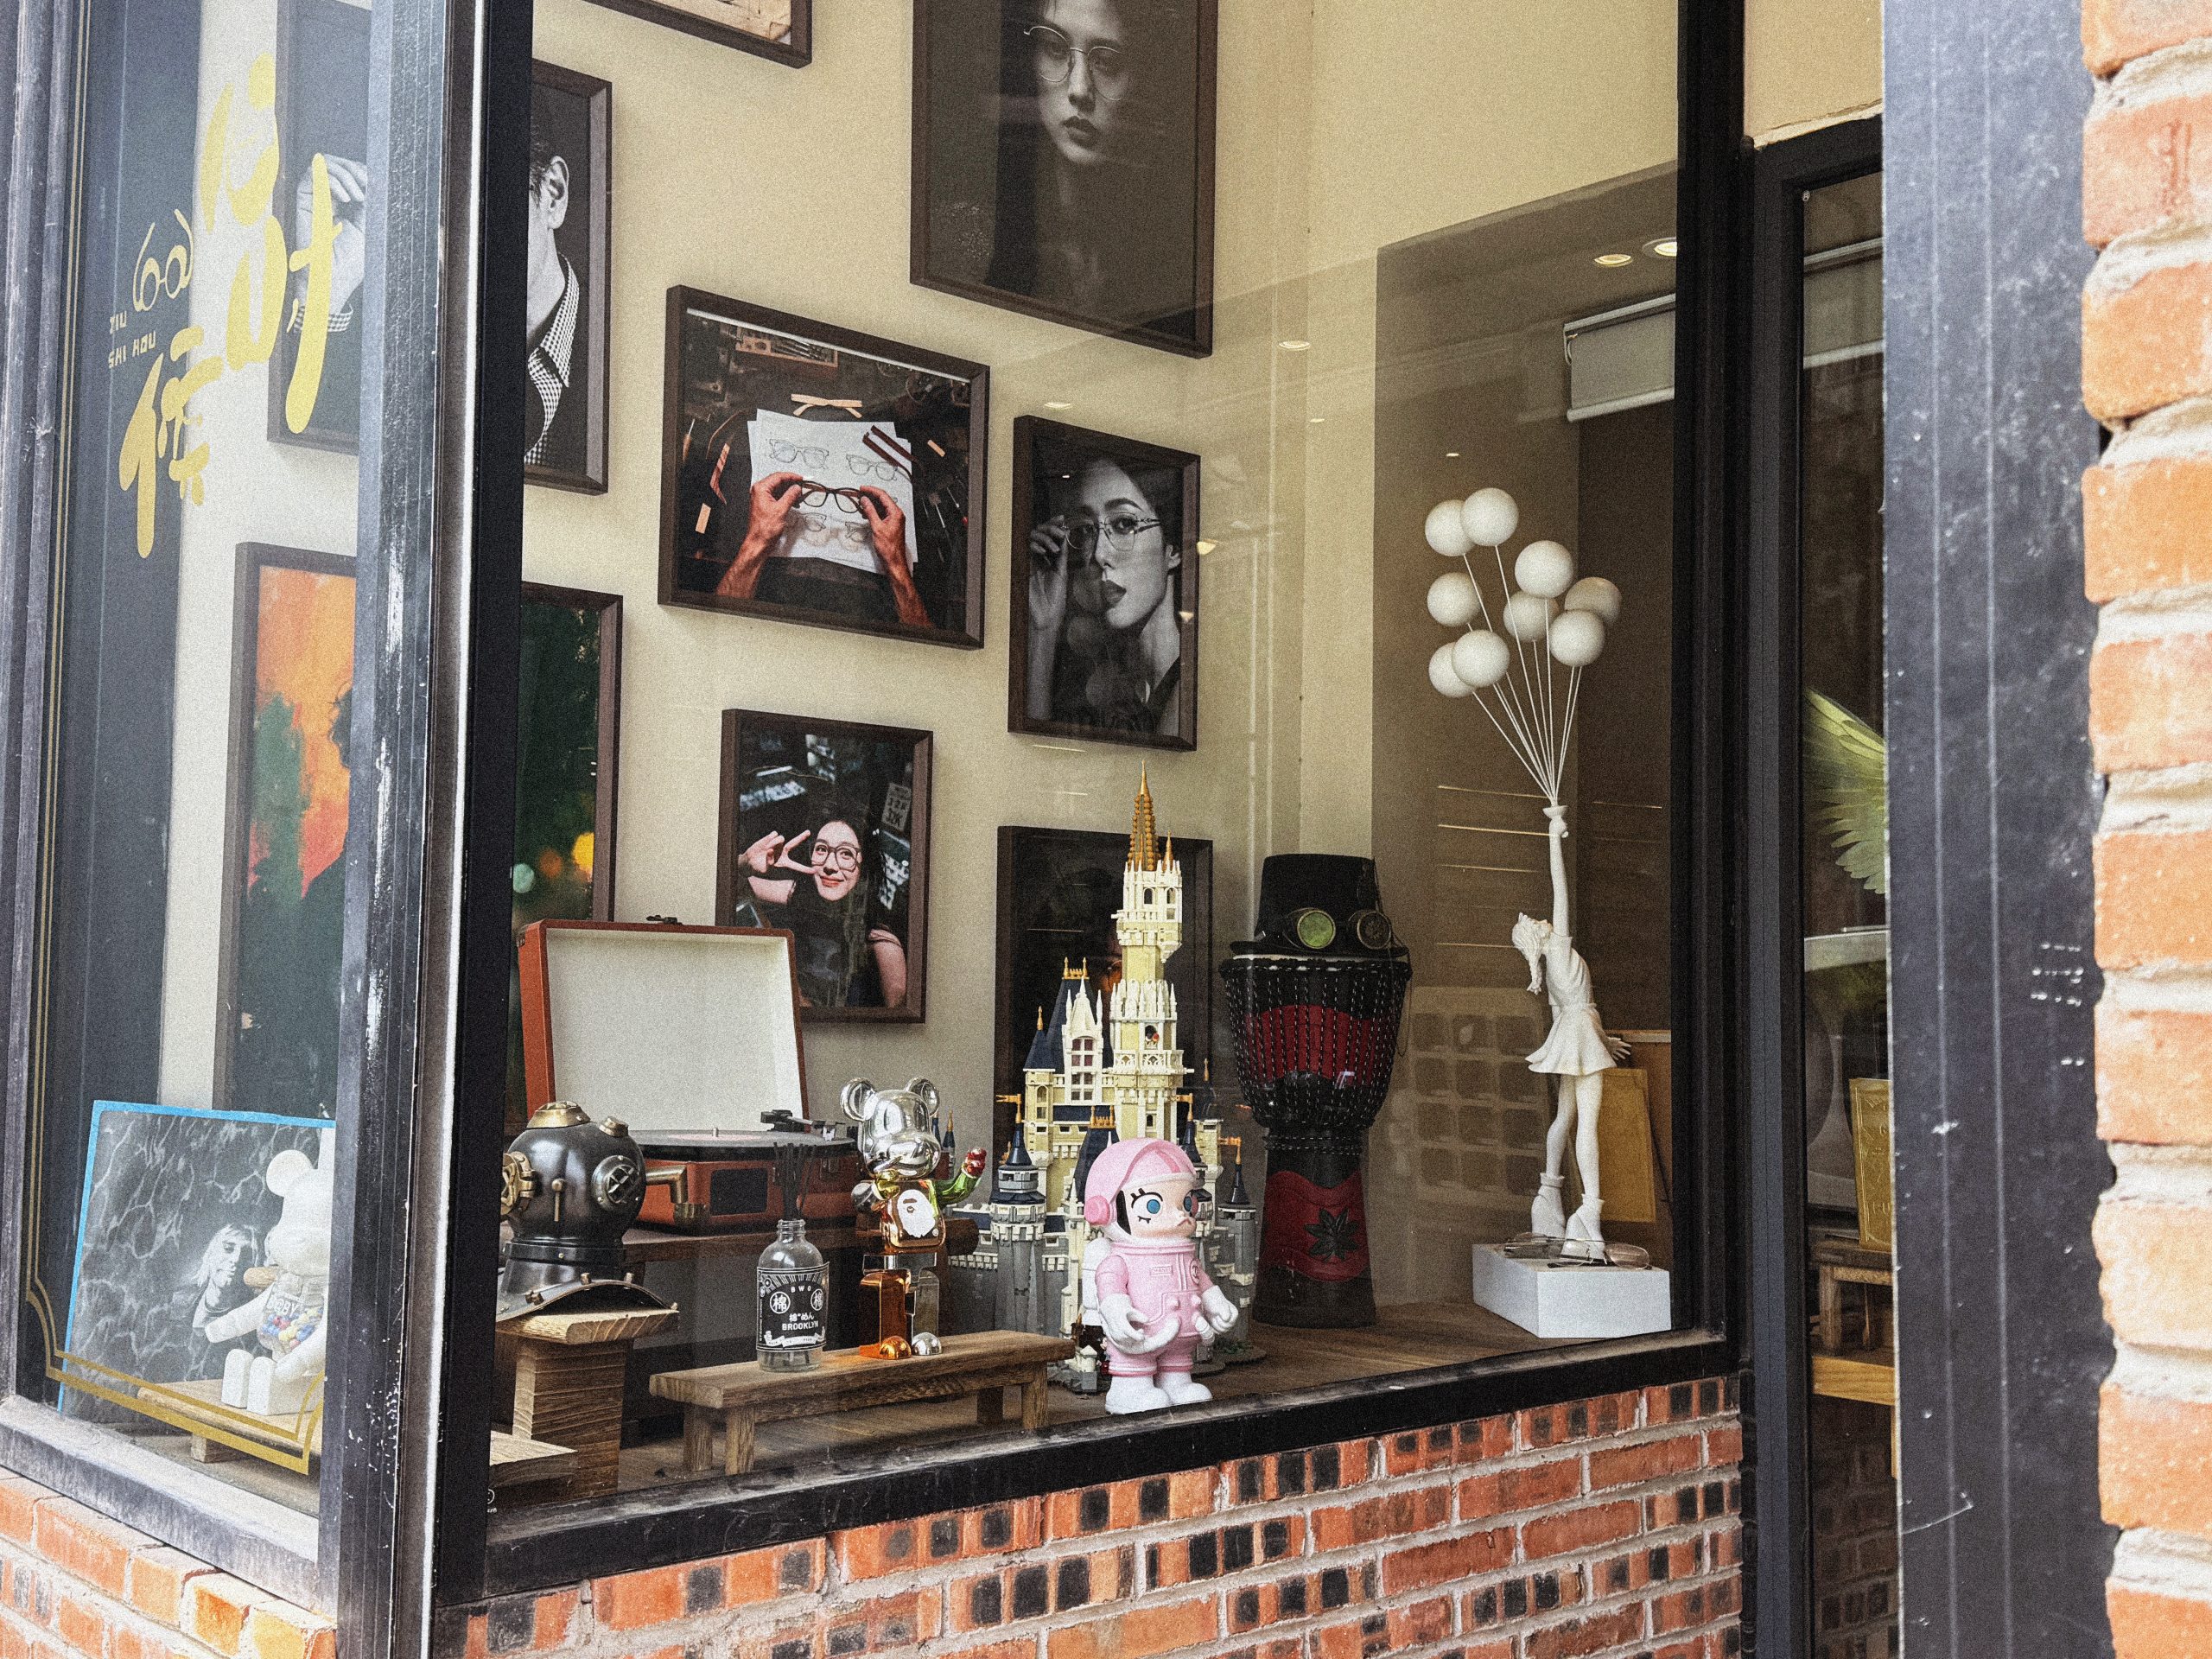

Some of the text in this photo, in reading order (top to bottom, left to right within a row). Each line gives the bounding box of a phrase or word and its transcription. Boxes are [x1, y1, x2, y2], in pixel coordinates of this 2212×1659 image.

[108, 330, 156, 369] SHI HOU
[782, 1320, 818, 1331] BROOKLYN
